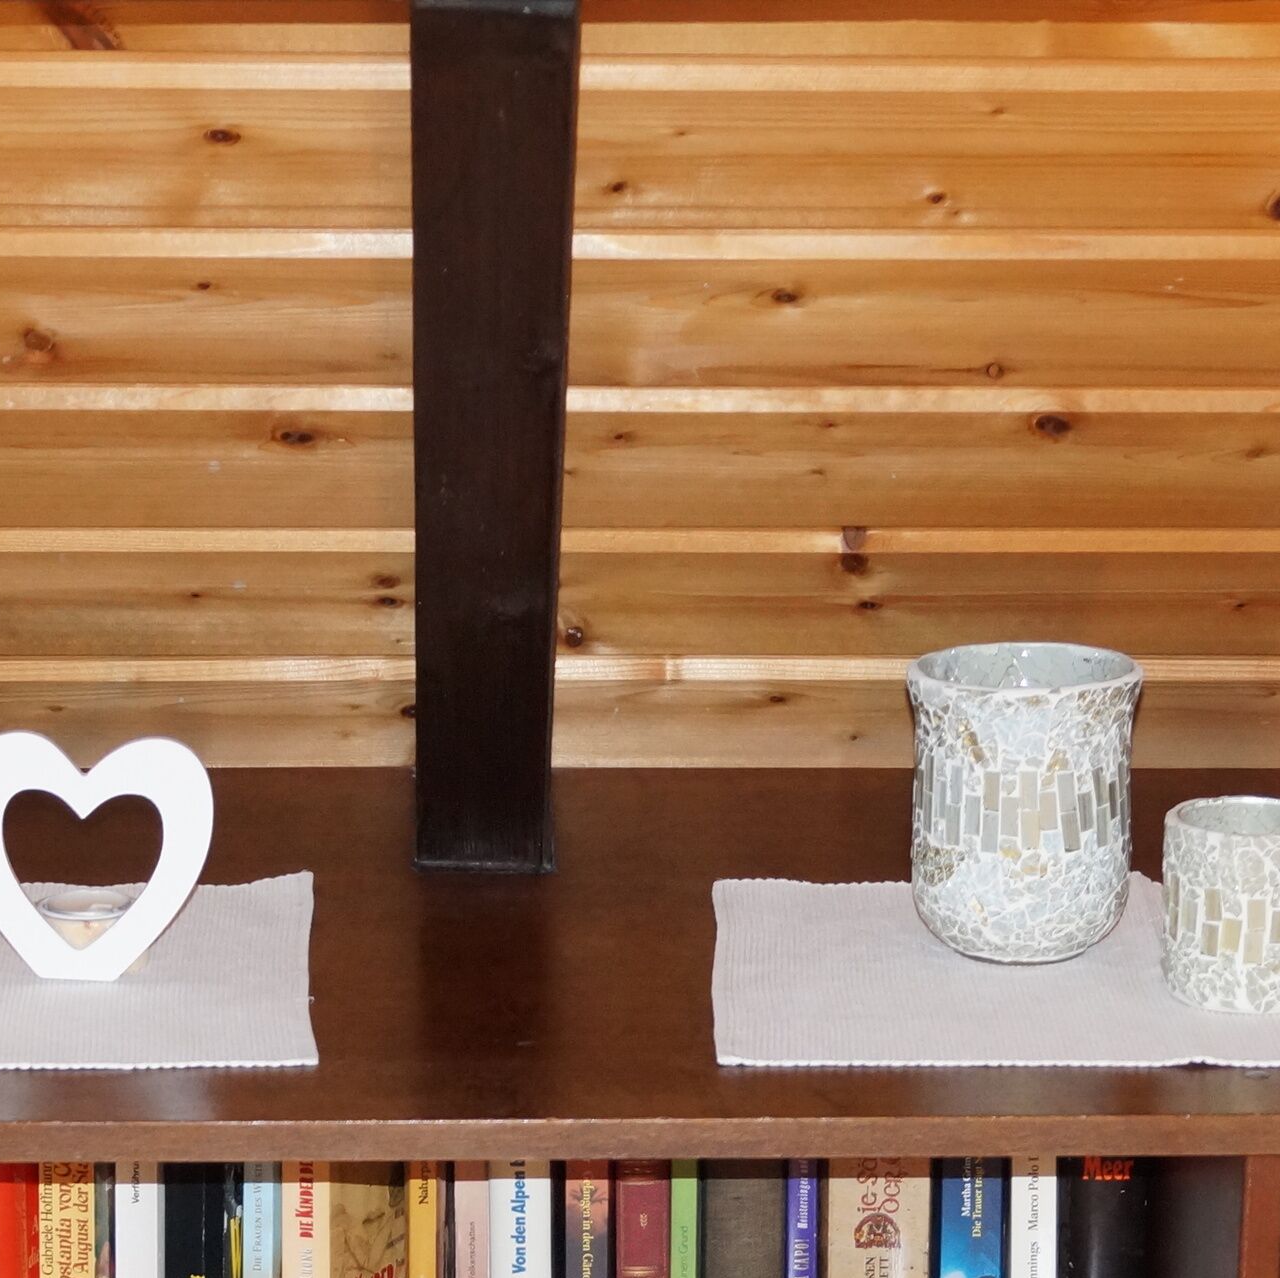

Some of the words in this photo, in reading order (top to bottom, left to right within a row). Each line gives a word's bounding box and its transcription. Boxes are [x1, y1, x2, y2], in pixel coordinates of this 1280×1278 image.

[1028, 1164, 1039, 1191] Polo
[1082, 1156, 1134, 1180] Meer
[58, 1182, 72, 1211] von
[73, 1187, 89, 1213] der
[296, 1176, 314, 1219] KINDER
[512, 1170, 530, 1213] Alpen
[961, 1182, 972, 1217] Martha
[973, 1189, 982, 1219] Trauer
[582, 1221, 593, 1231] in
[1028, 1193, 1039, 1232] Marco
[300, 1221, 314, 1239] DIE
[512, 1214, 526, 1244] den
[581, 1233, 593, 1250] den
[973, 1220, 982, 1238] Die
[42, 1224, 54, 1276] Gabriele
[73, 1217, 93, 1273] August
[512, 1246, 526, 1274] Von
